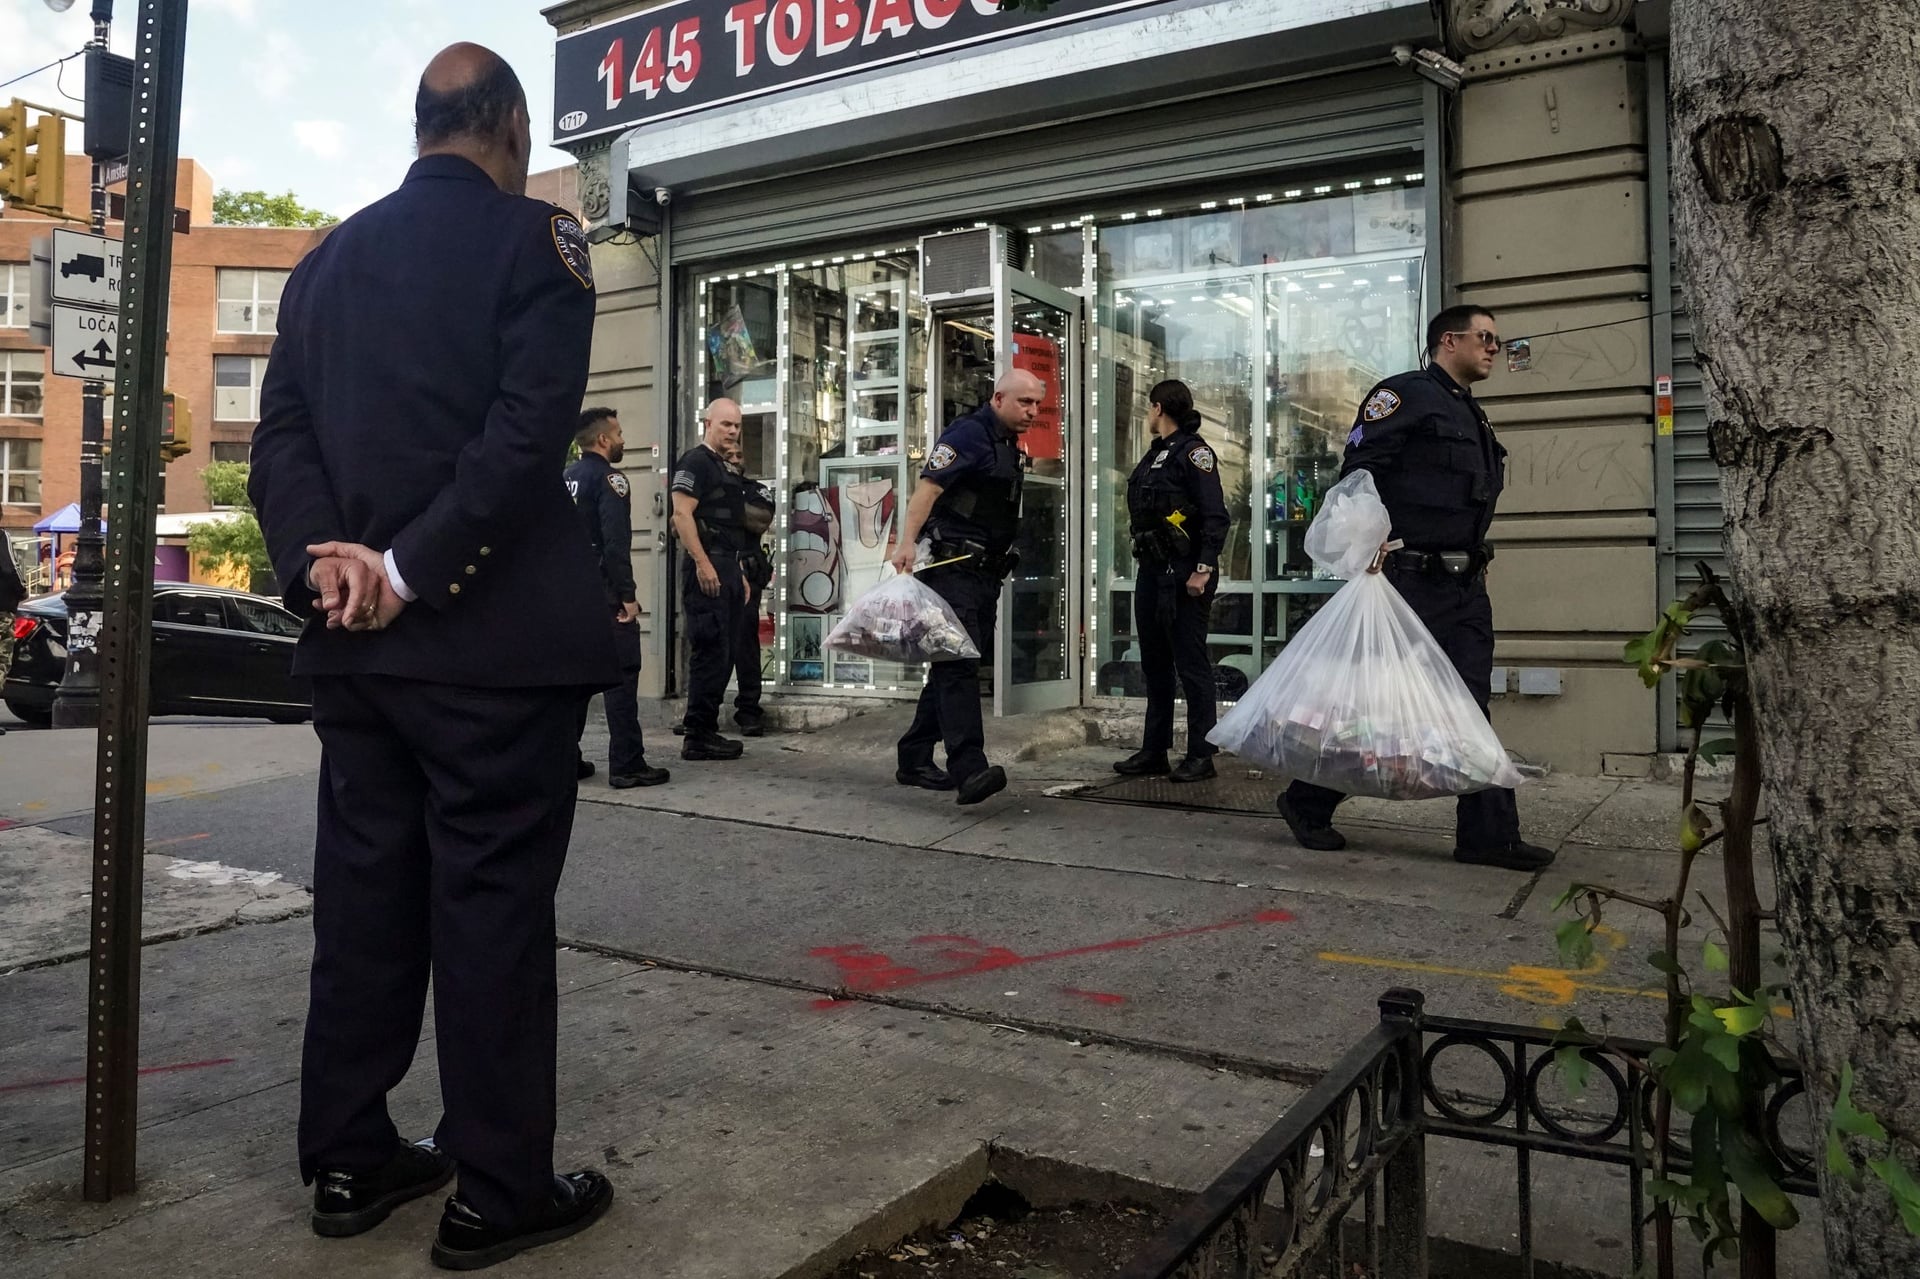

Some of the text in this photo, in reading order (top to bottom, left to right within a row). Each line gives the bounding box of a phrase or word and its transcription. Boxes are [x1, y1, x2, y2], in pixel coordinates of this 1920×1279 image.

[598, 16, 702, 110] 145
[562, 112, 583, 129] 1717
[557, 235, 571, 254] CITY
[79, 315, 117, 334] LOCA
